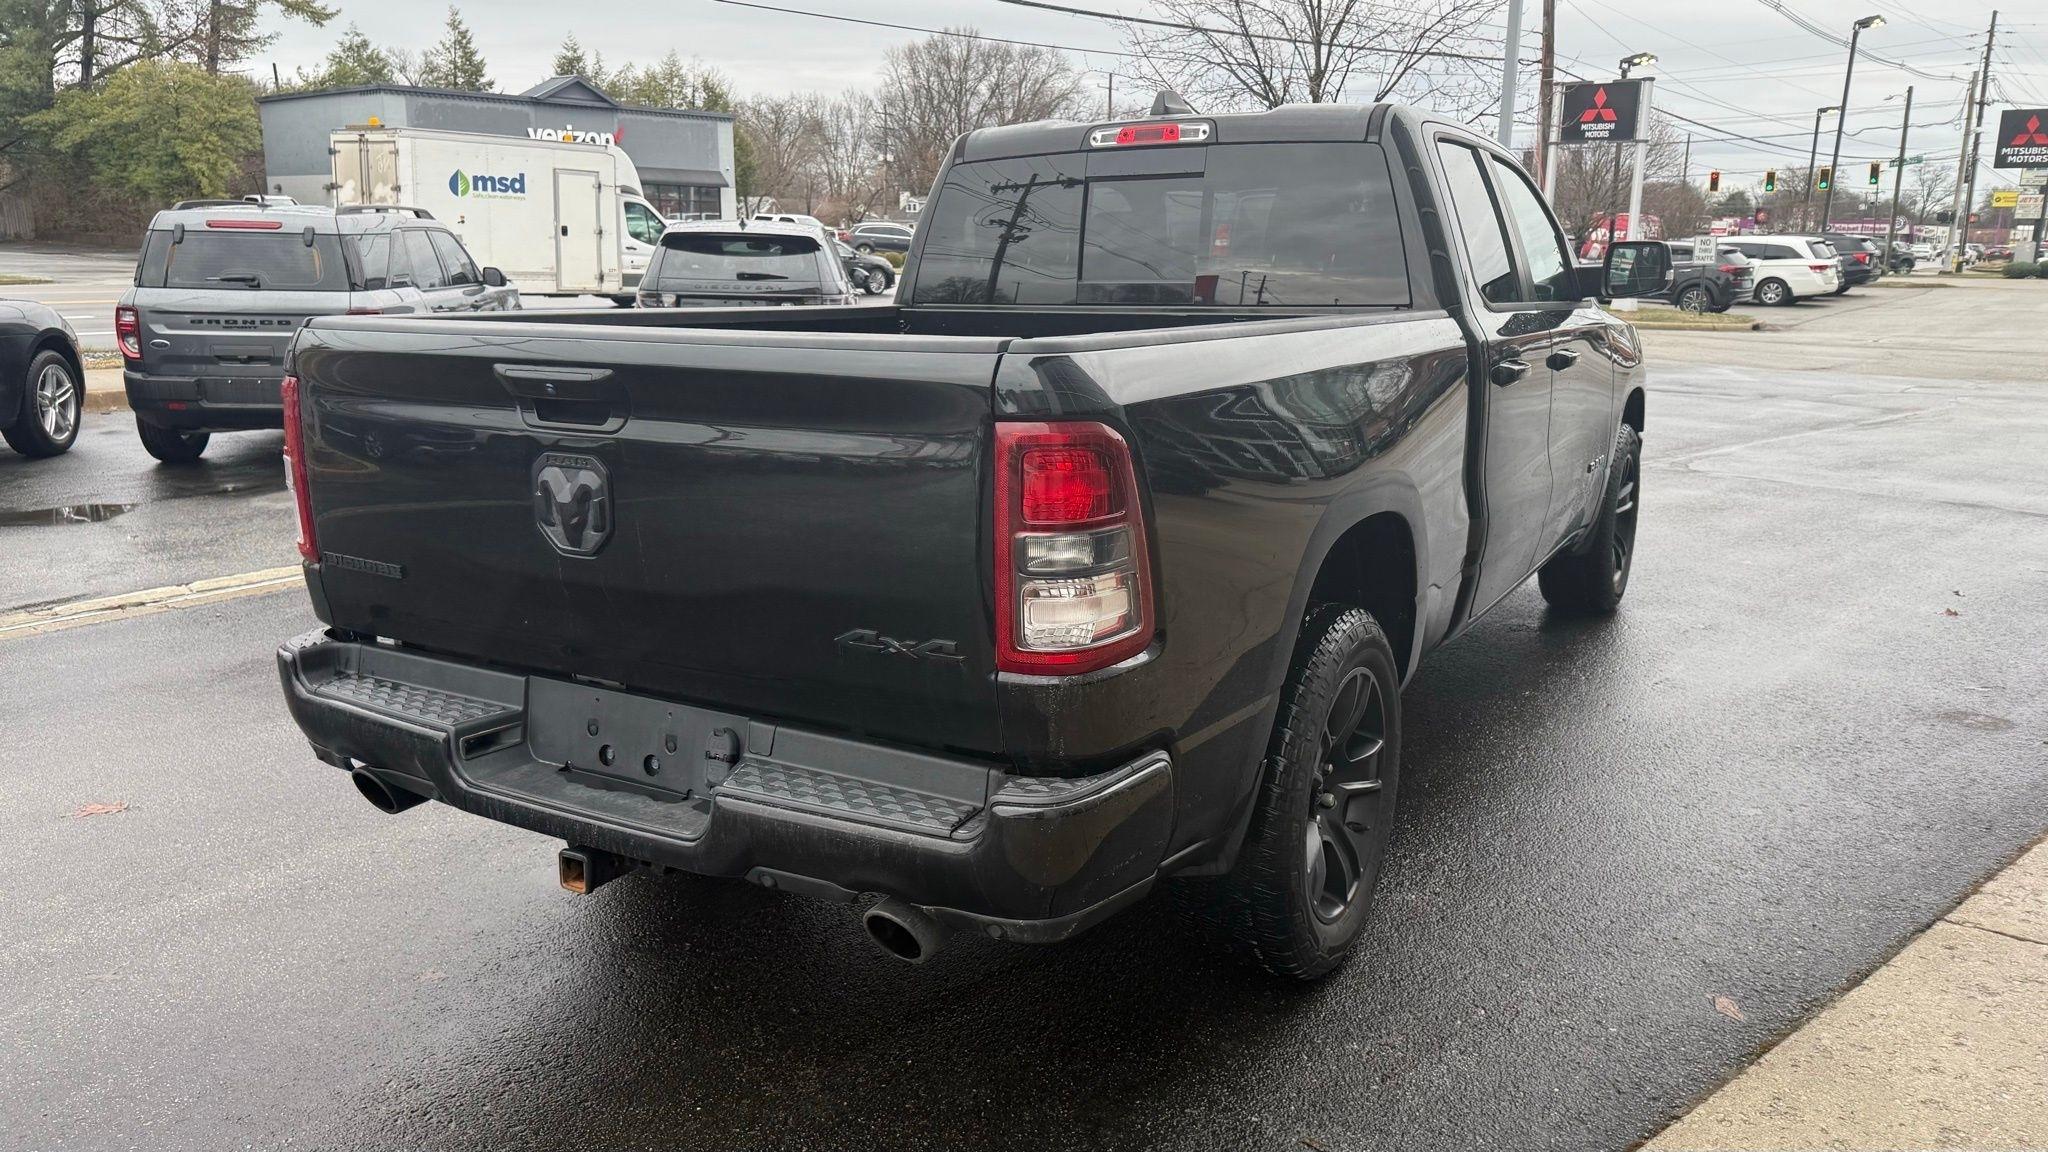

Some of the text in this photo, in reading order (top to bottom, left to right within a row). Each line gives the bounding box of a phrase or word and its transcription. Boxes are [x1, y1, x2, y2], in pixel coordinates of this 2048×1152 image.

[1581, 122, 1615, 130] MITSUBISHI
[527, 124, 615, 146] verizon
[2001, 147, 2048, 155] MITSUBIS
[2007, 155, 2048, 163] MOTORS
[472, 173, 526, 194] msd
[1700, 238, 1711, 246] NO
